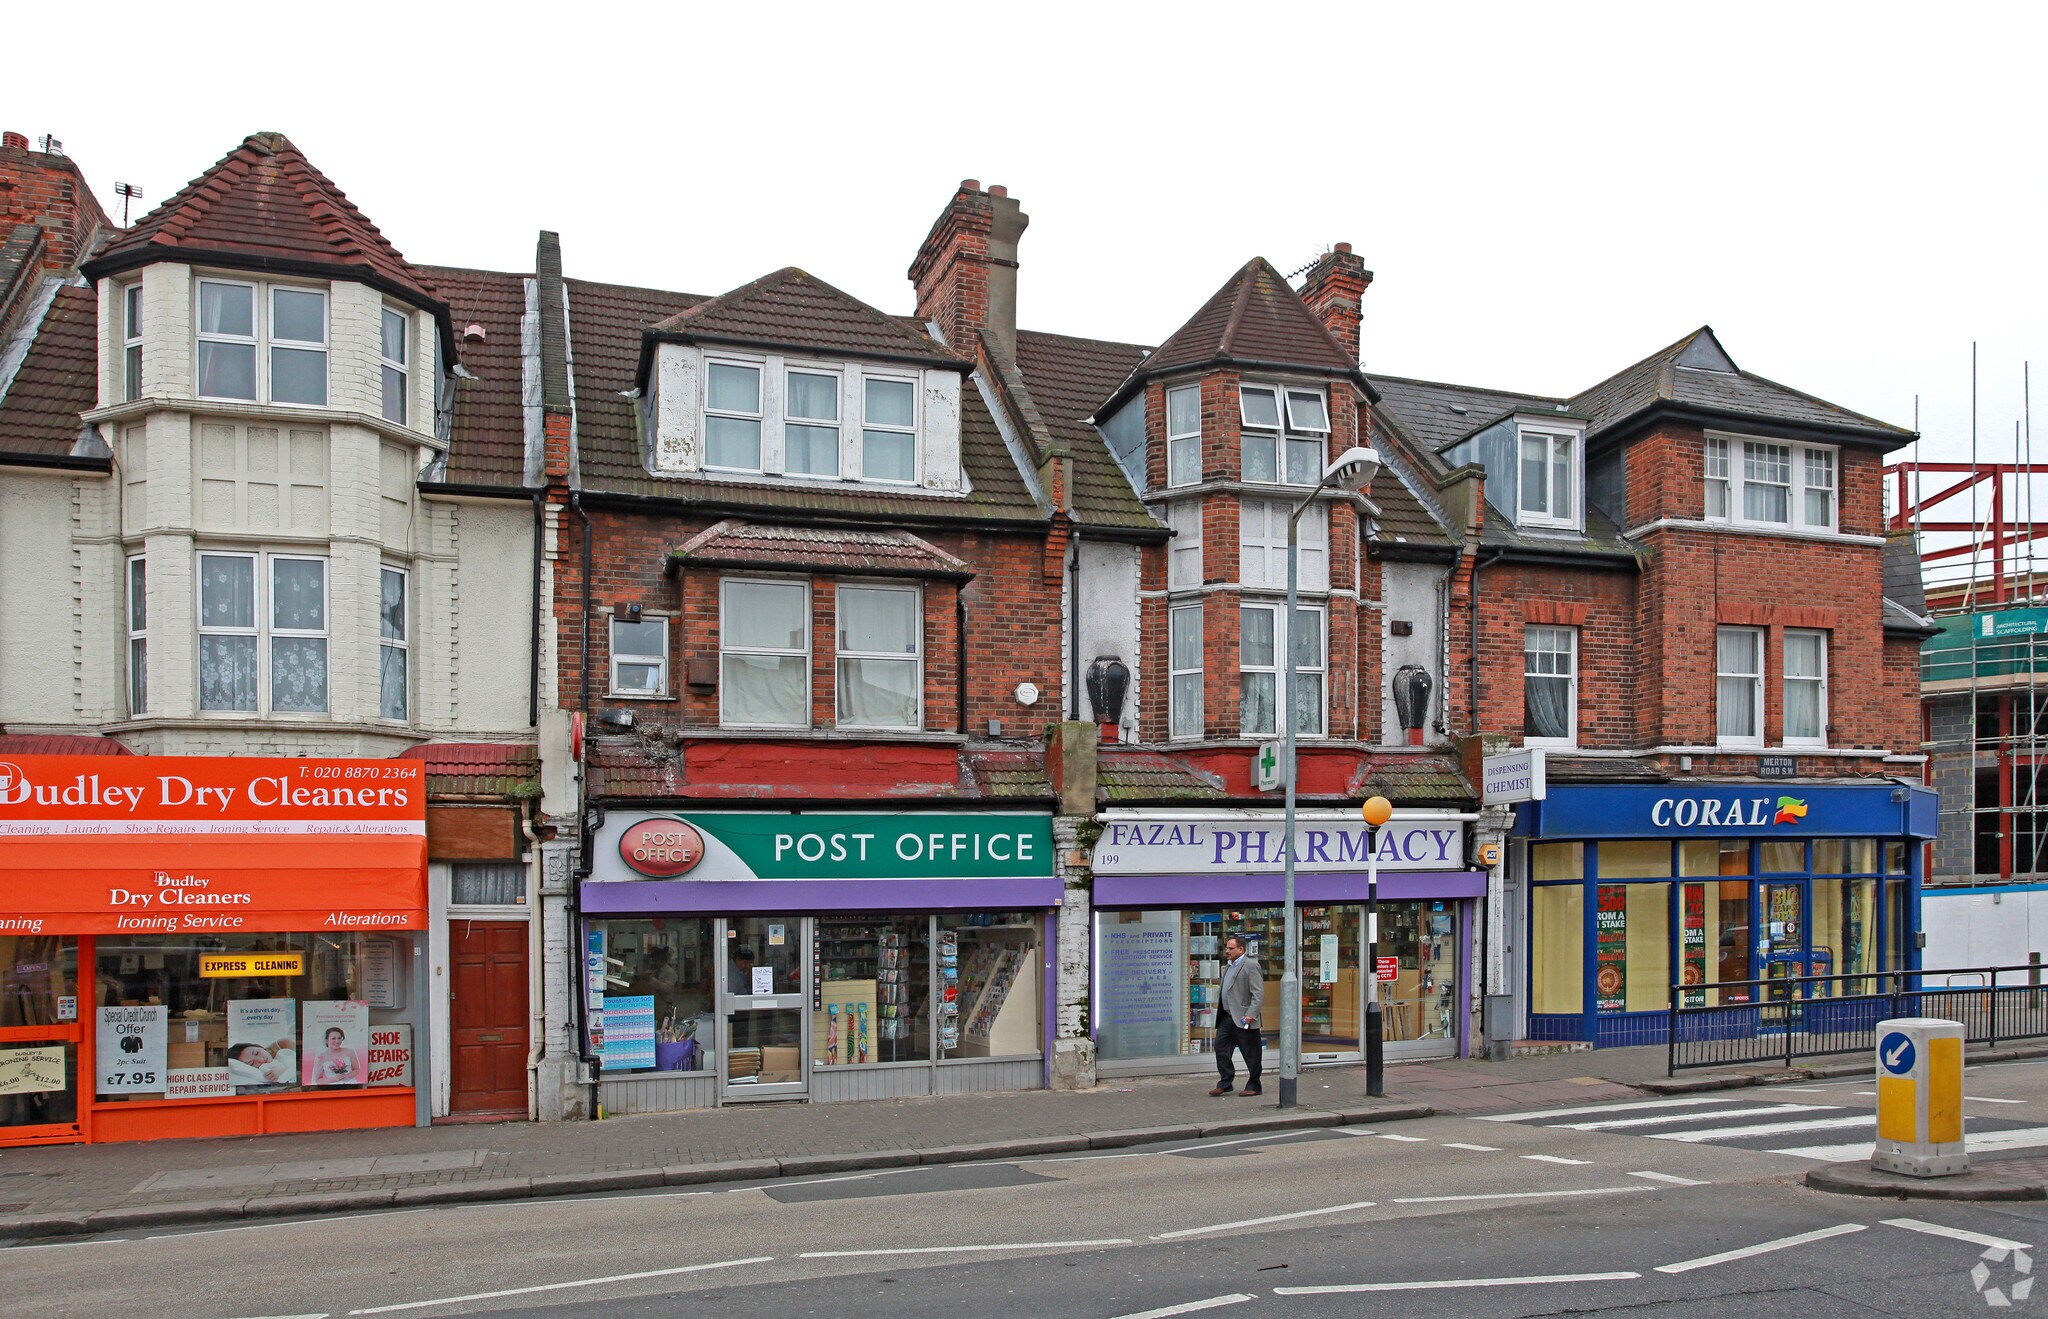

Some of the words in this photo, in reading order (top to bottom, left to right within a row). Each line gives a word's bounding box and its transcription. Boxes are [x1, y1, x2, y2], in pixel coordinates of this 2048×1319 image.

[1996, 620, 2037, 629] ARCHITECTURAL
[1996, 626, 2038, 635] SCAFFOLDING
[1763, 757, 1793, 767] MERTON
[314, 767, 340, 778] 020
[345, 767, 379, 778] 8870
[382, 767, 417, 779] 2364
[1487, 762, 1529, 777] DISPENSING
[1760, 767, 1780, 775] ROAD
[1782, 767, 1795, 775] S.W.
[0, 762, 145, 812] Dudley
[157, 776, 236, 812] Dry
[248, 776, 408, 807] Cleaners
[1486, 777, 1531, 794] CHEMIST
[1651, 798, 1768, 827] CORAL
[0, 824, 50, 835] Cleaning
[65, 824, 111, 834] Laundry
[125, 824, 153, 833] Shoe
[156, 824, 196, 834] Repairs
[210, 824, 248, 834] Ironing
[252, 824, 290, 833] Service
[306, 824, 340, 833] Repair
[342, 824, 351, 833] &
[354, 824, 408, 833] Alterations
[642, 832, 686, 846] POST
[1110, 824, 1204, 846] FAZAL
[1211, 829, 1457, 864] PHARMACY
[775, 833, 875, 861] POST
[895, 833, 1033, 861] OFFICE
[633, 848, 691, 863] OFFICE
[1101, 854, 1119, 865] 199
[1487, 851, 1497, 859] ADT
[110, 889, 153, 908] Dry
[159, 888, 251, 905] Cleaners
[1618, 911, 1625, 920] A
[117, 915, 178, 932] Ironing
[182, 914, 242, 928] Service
[324, 912, 408, 926] Alterations
[1601, 920, 1625, 928] STAKE
[1684, 936, 1704, 944] STAKE
[205, 961, 247, 972] EXPRESS
[254, 960, 298, 970] CLEANING
[104, 1008, 123, 1025] Special
[123, 1008, 139, 1022] Credit
[139, 1007, 157, 1021] Crunch
[116, 1024, 146, 1034] Offer
[371, 1031, 400, 1045] SHOE
[32, 1056, 61, 1065] SERVICE
[35, 1074, 61, 1085] £12.00
[107, 1072, 156, 1085] £7.95
[167, 1074, 185, 1084] HIGH
[187, 1073, 212, 1083] CLASS
[368, 1064, 405, 1083] HERE
[170, 1085, 196, 1094] REPAIR
[199, 1084, 231, 1093] SERVICE
